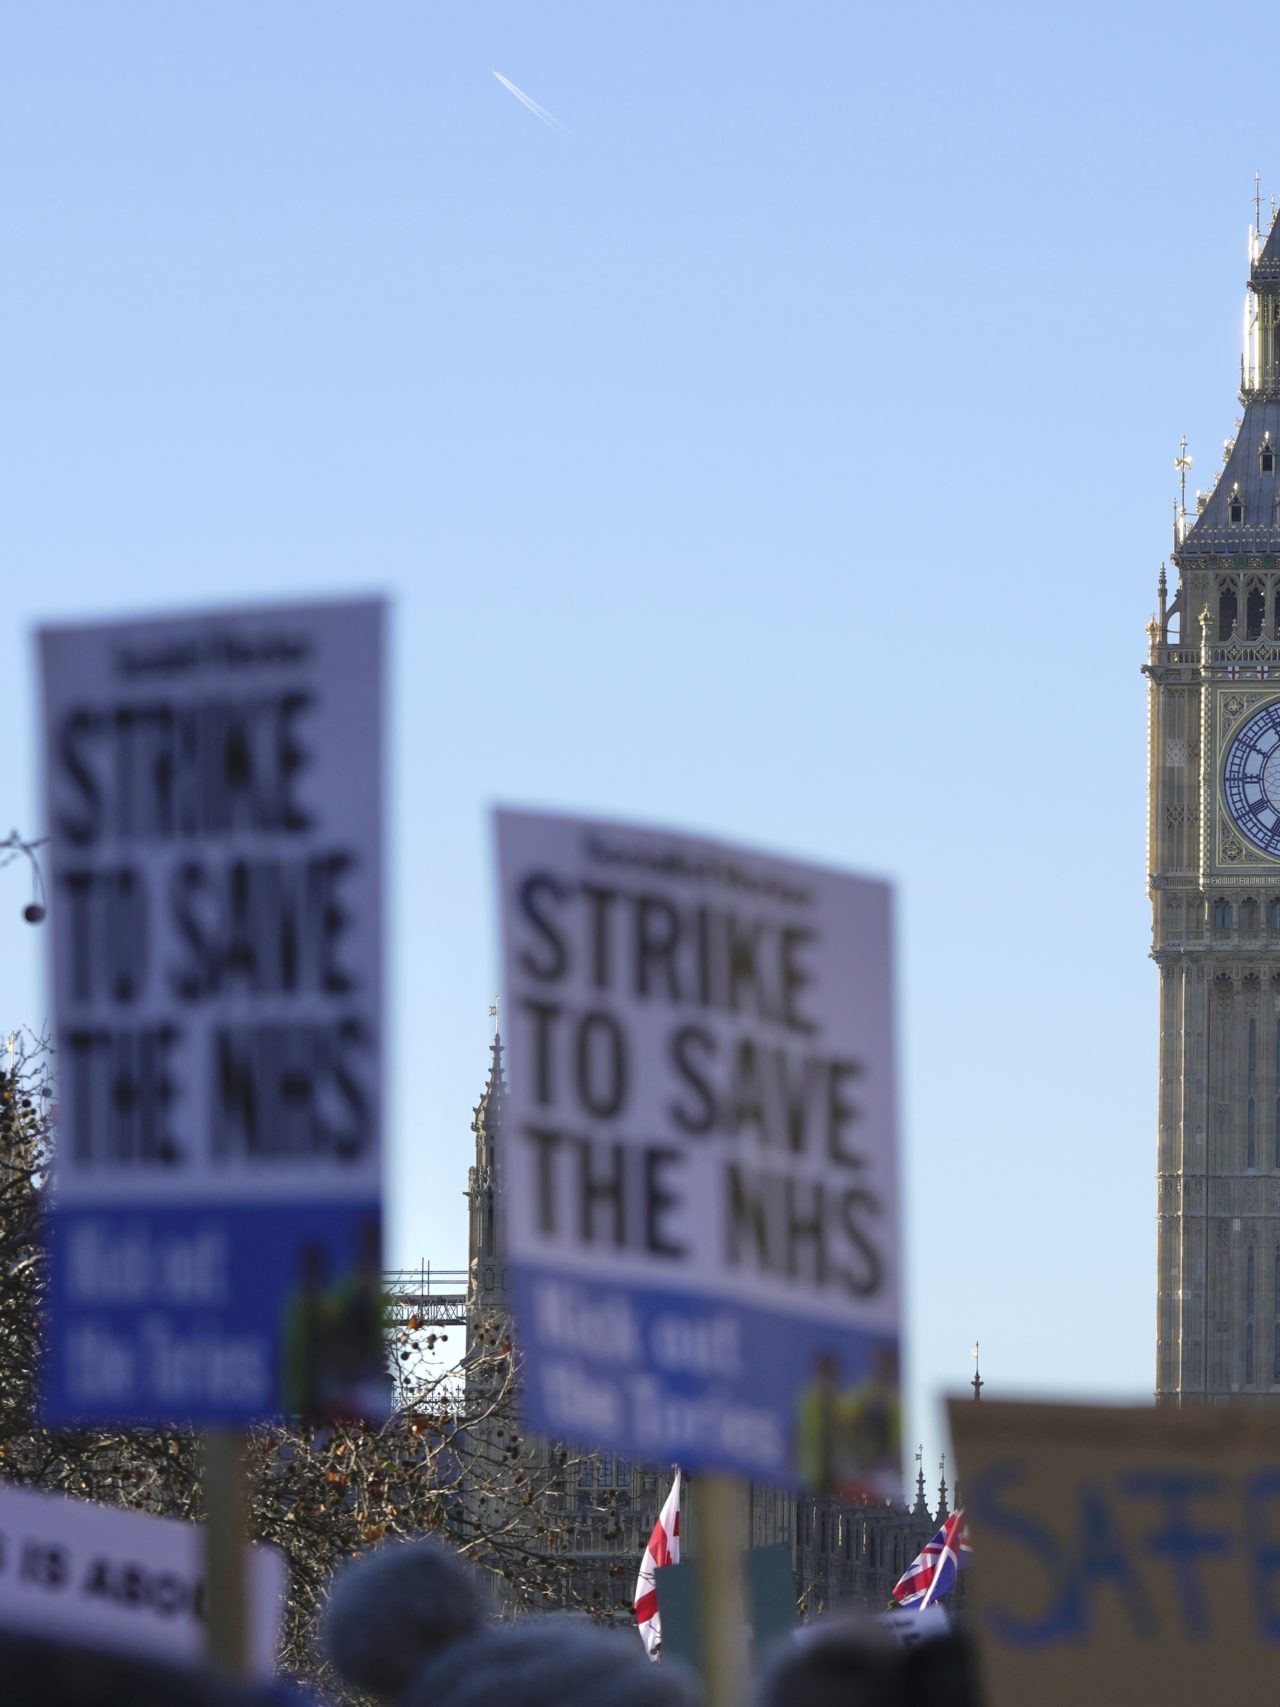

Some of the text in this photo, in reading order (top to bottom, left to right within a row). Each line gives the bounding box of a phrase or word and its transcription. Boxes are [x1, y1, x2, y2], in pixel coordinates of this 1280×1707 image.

[58, 693, 316, 848] STRIKE
[62, 850, 354, 1006] TO SAVE
[520, 870, 818, 1038] STRIKE
[66, 1012, 373, 1168] THE NHS
[520, 994, 865, 1170] TO SAVE
[522, 1125, 883, 1304] THE NHS
[20, 1537, 69, 1590] IS
[82, 1554, 206, 1621] ABO
